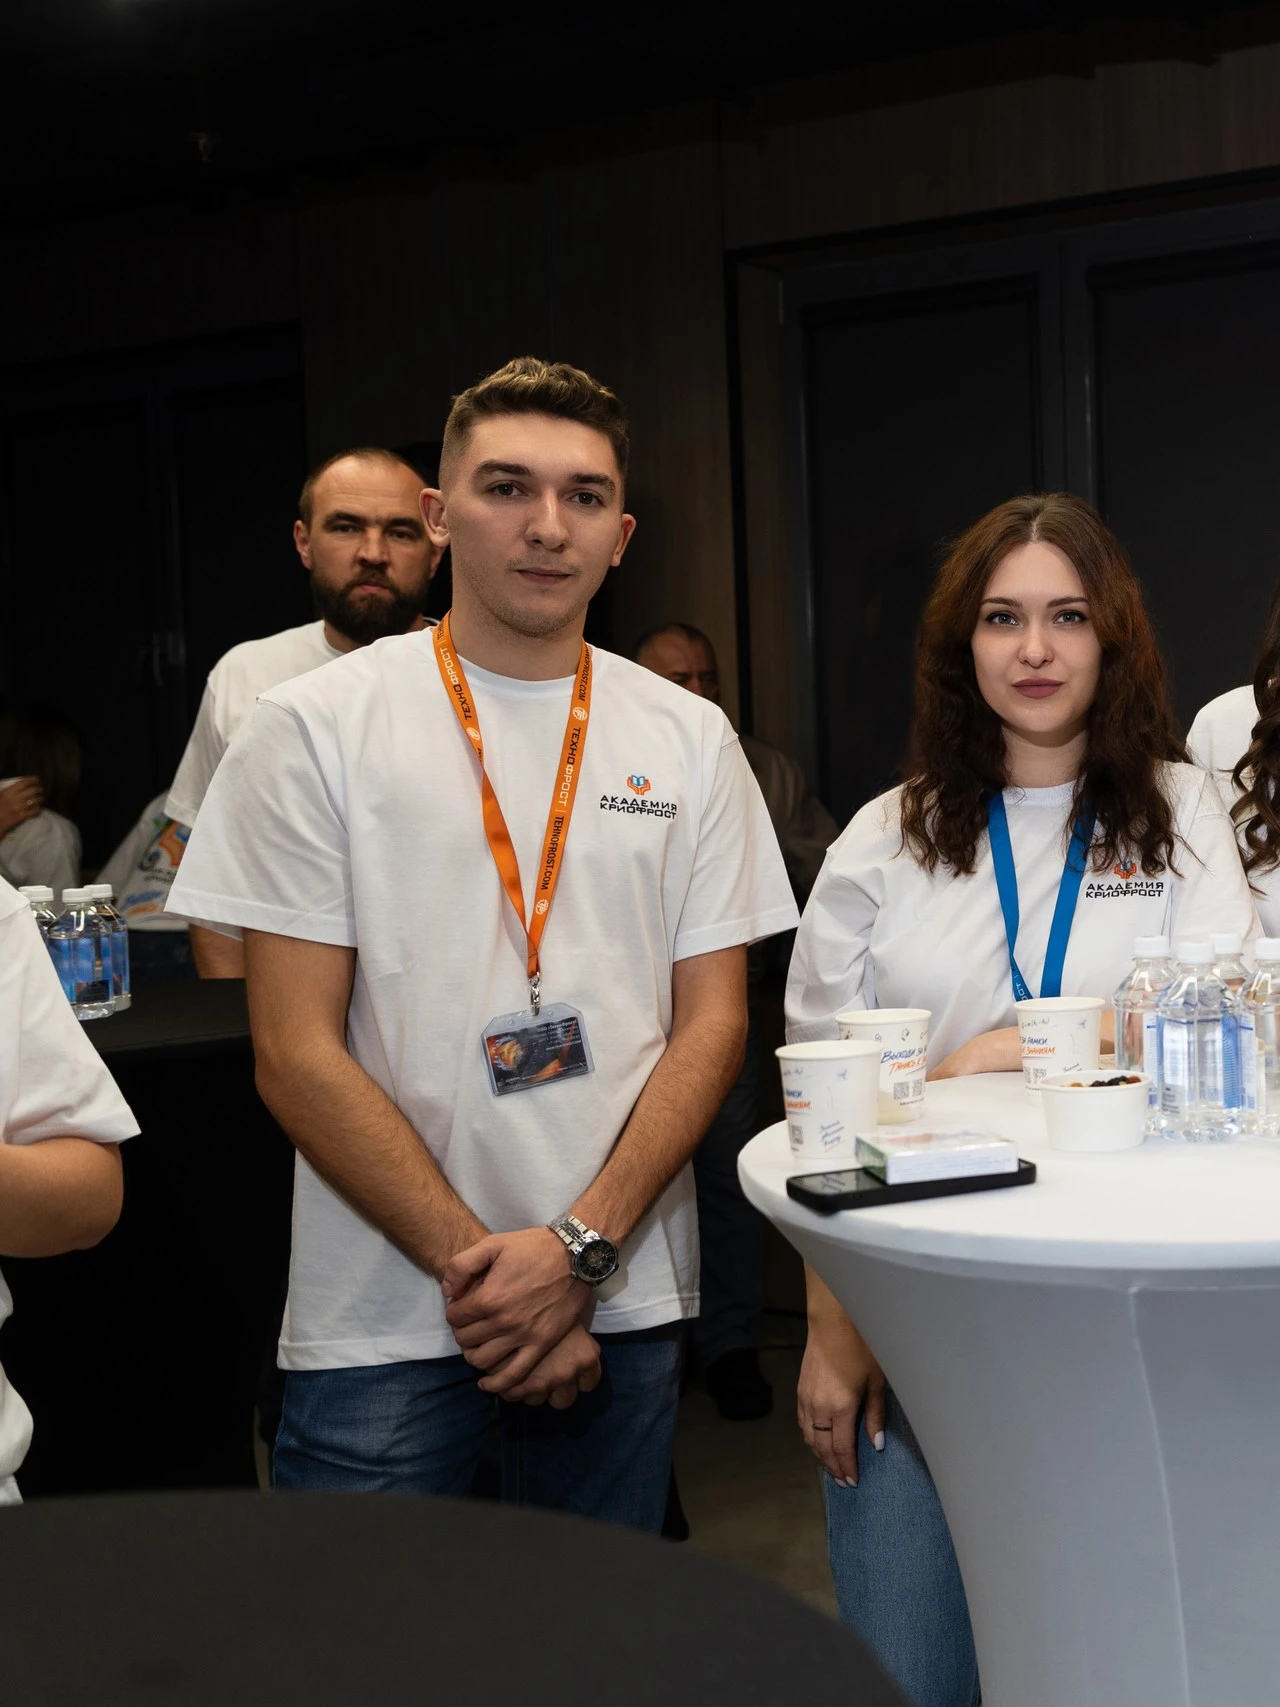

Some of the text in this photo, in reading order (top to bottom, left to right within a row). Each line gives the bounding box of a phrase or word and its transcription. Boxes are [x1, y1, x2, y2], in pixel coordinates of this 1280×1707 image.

[440, 647, 472, 720] ТЕХНОФРОСТ
[559, 727, 581, 806] ТЕХНОФРОСТ
[600, 795, 677, 812] АКАДЕМИЯ
[600, 803, 677, 819] КРИОФРОСТ
[541, 816, 565, 890] TEHNOFROST.COM
[1085, 889, 1164, 899] КРИОФРОСТ
[1087, 881, 1164, 891] АКАДЕМИЯ
